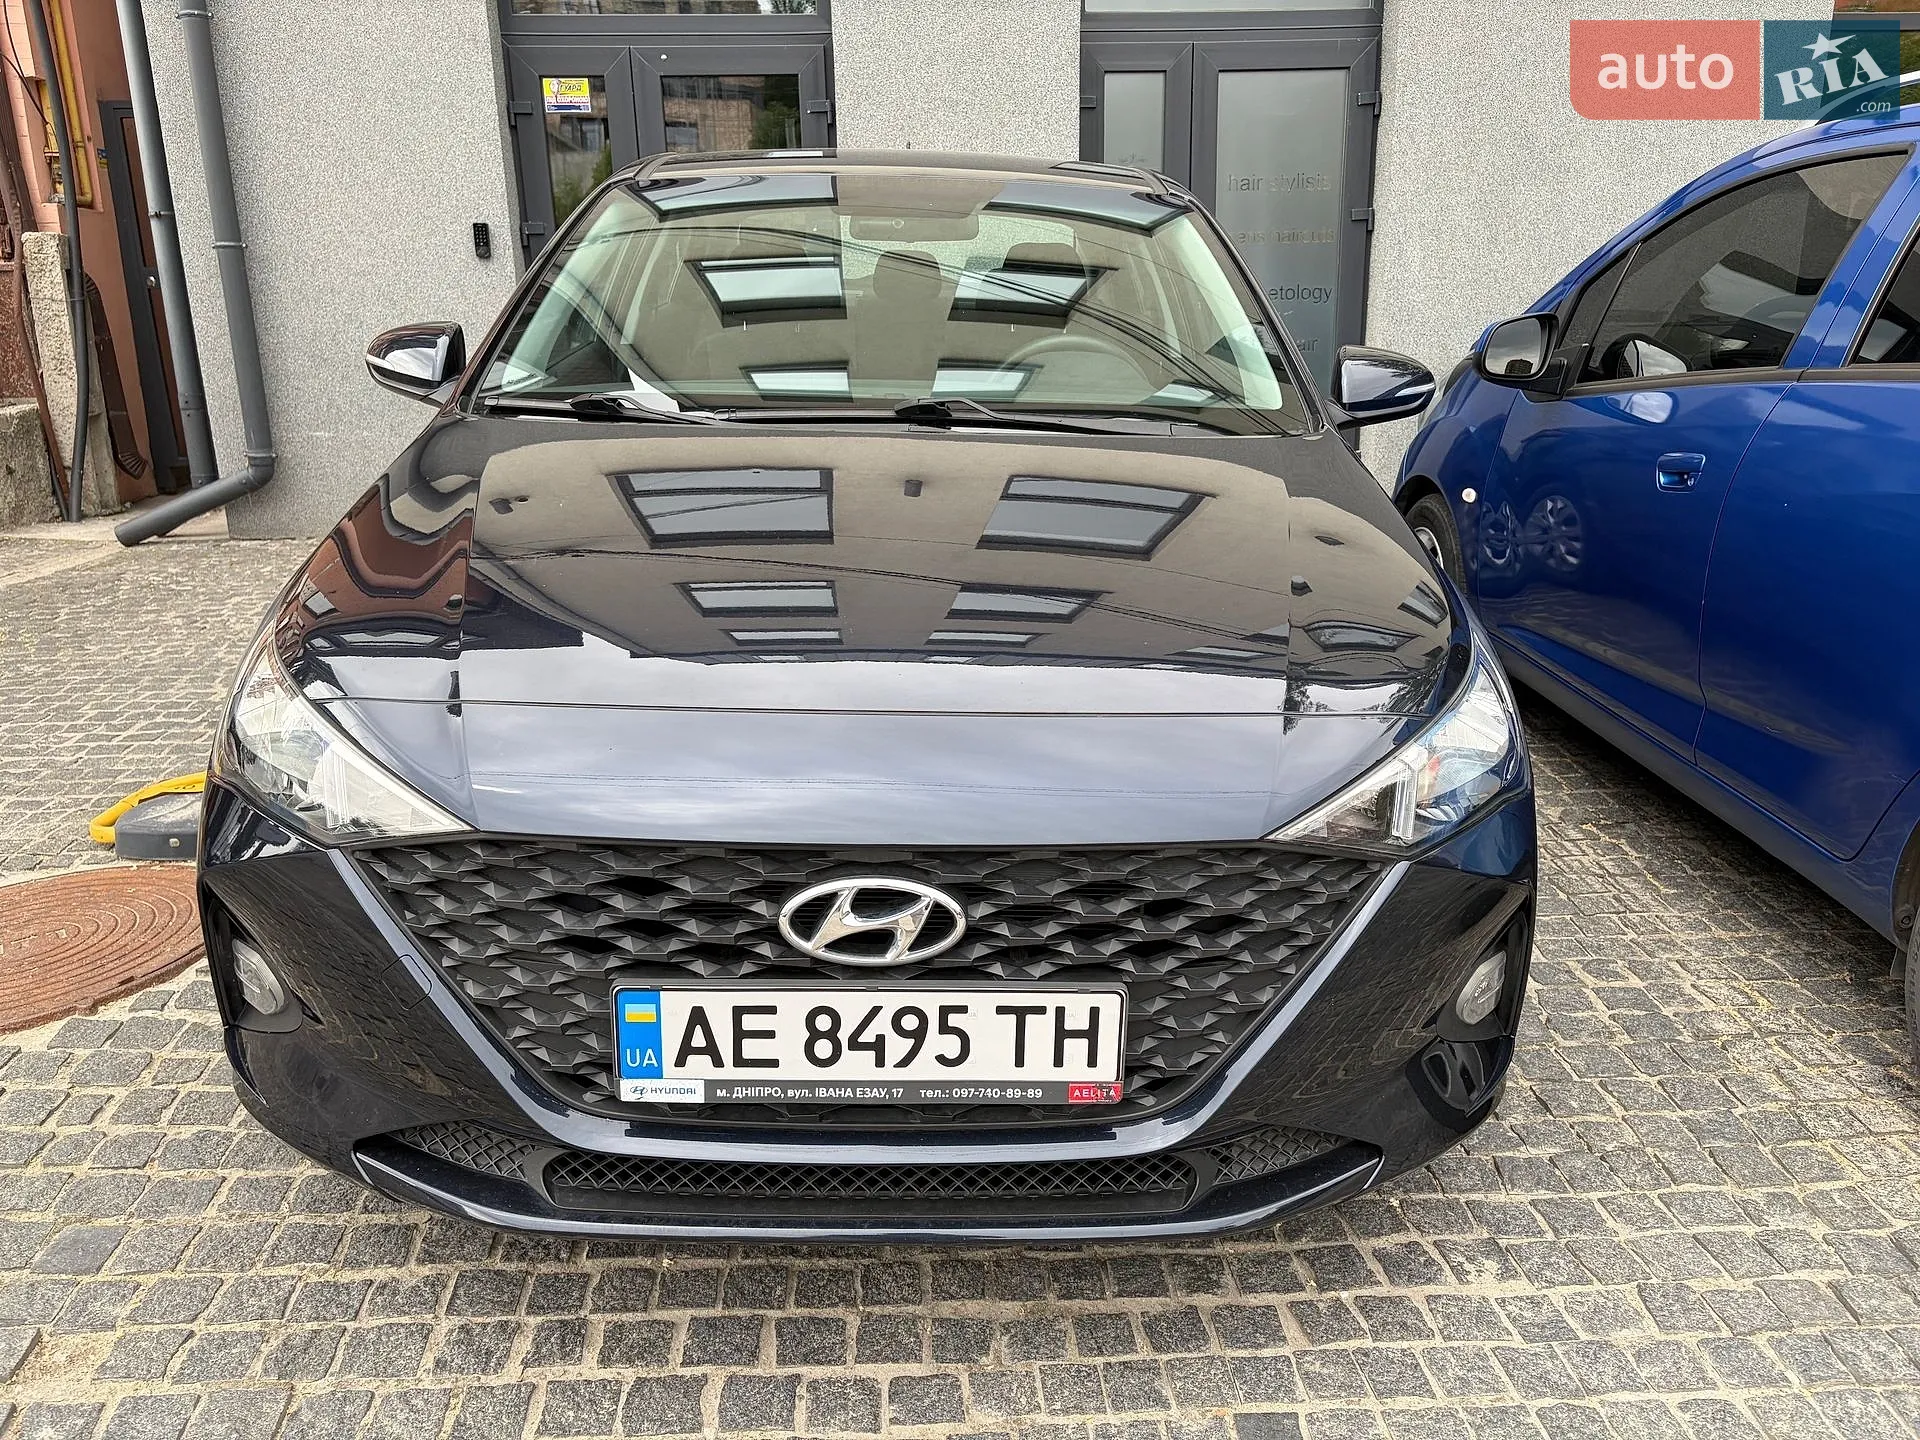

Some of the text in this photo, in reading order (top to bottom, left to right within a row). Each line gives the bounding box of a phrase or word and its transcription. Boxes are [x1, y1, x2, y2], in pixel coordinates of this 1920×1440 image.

[1228, 173, 1263, 192] hair
[1269, 283, 1333, 304] etology
[1296, 338, 1319, 352] air
[674, 1005, 1100, 1068] AE 8495 TH
[626, 1048, 658, 1068] UA
[650, 1087, 697, 1095] HYUNDAI
[716, 1086, 904, 1100] м. ДНІПРО, вул. ІВАНА ЕЗАУ, 17
[919, 1088, 1043, 1099] тел.: 097-740-89-89
